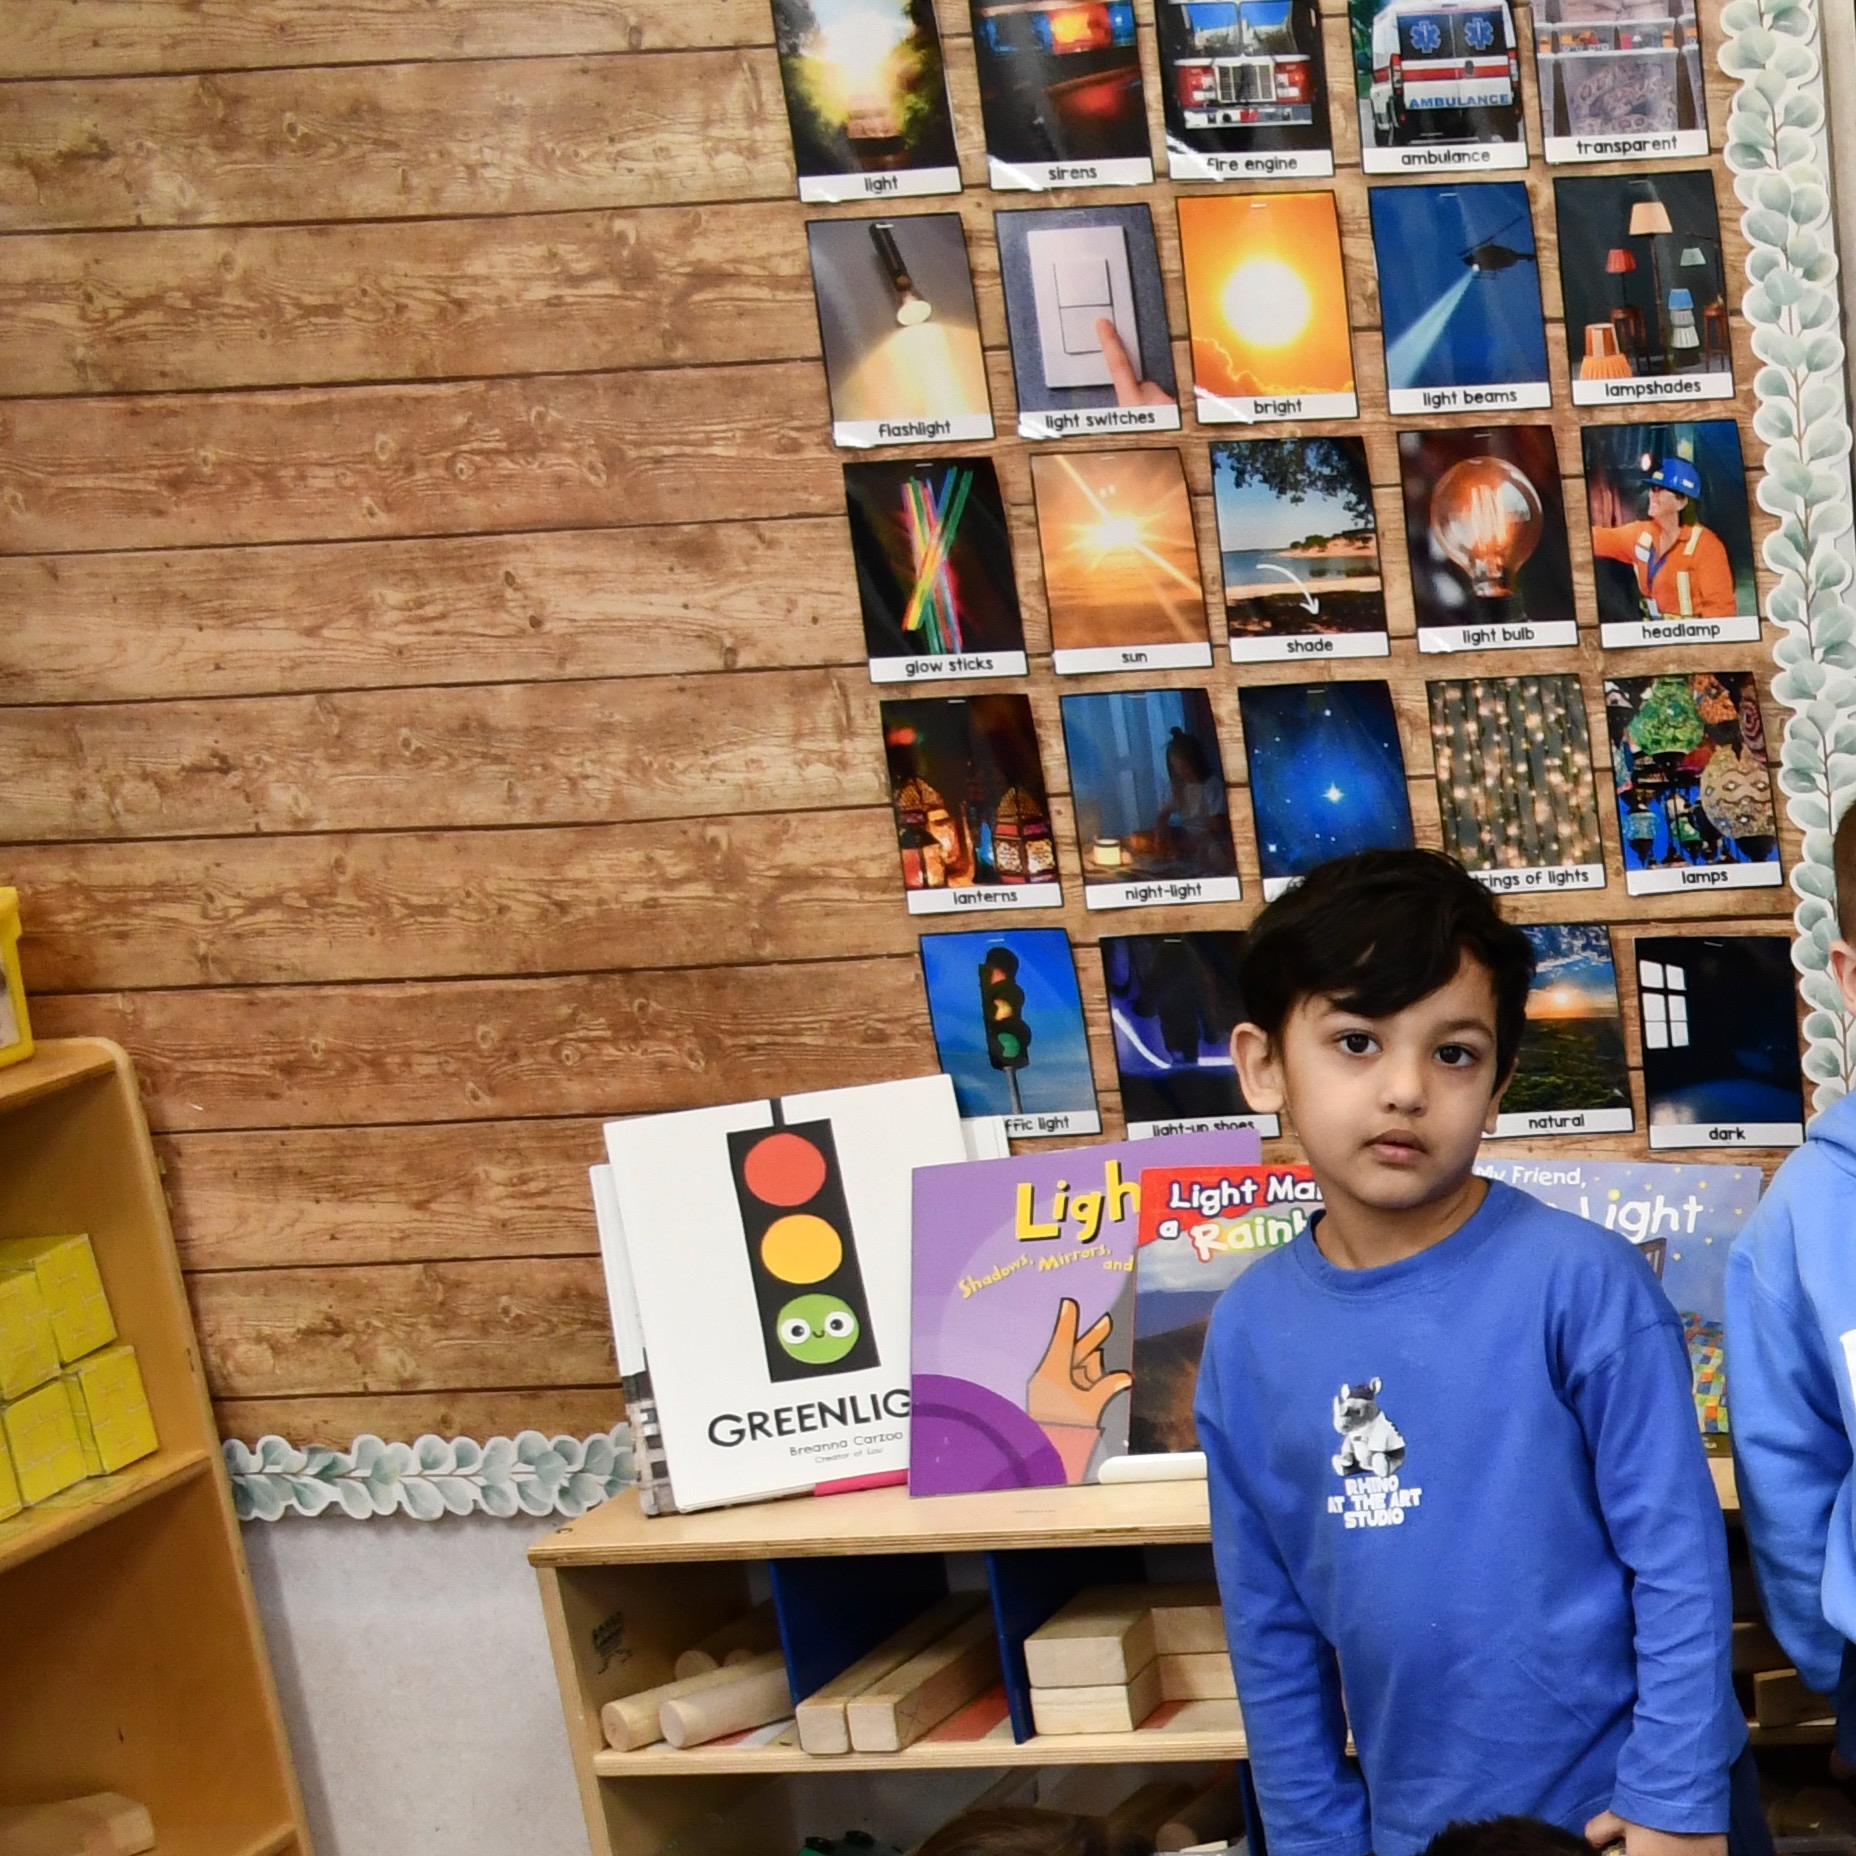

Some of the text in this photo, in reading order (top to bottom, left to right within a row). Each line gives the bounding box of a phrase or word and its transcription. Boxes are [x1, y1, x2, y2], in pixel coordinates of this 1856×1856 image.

[1409, 94, 1509, 108] AMBULANCE
[1576, 135, 1679, 157] transparent
[1207, 156, 1298, 175] fire engine
[1401, 148, 1491, 166] ambulance
[1048, 165, 1097, 182] sirens
[864, 175, 899, 194] light
[1422, 387, 1517, 408] light beams
[1603, 378, 1702, 400] lampshades
[1253, 397, 1303, 418] bright
[878, 419, 951, 438] flashlight
[1045, 409, 1156, 430] light switches
[1461, 625, 1535, 645] light bulb
[1641, 622, 1721, 640] headlamp
[1286, 637, 1334, 654] shade
[905, 655, 993, 677] glow sticks
[1121, 650, 1149, 664] sun
[1525, 869, 1544, 886] of
[1547, 868, 1590, 886] lights
[1681, 869, 1729, 886] lamps
[952, 888, 1018, 906] lanterns
[1124, 882, 1203, 901] night-light
[1037, 1115, 1071, 1133] light
[1528, 1114, 1586, 1130] natural
[1708, 1126, 1746, 1141] dark
[1511, 1166, 1587, 1188] Friend,
[1170, 1177, 1259, 1216] Light
[1159, 1219, 1179, 1239] a
[958, 1243, 1112, 1299] Shadows, Mirrors,
[1103, 1255, 1136, 1272] and
[789, 1430, 904, 1457] Breanna Carzoo
[814, 1452, 850, 1464] Creator
[1345, 1475, 1400, 1496] RHINO
[1327, 1488, 1423, 1513] AT THE ART
[1343, 1508, 1405, 1529] STUDIO
